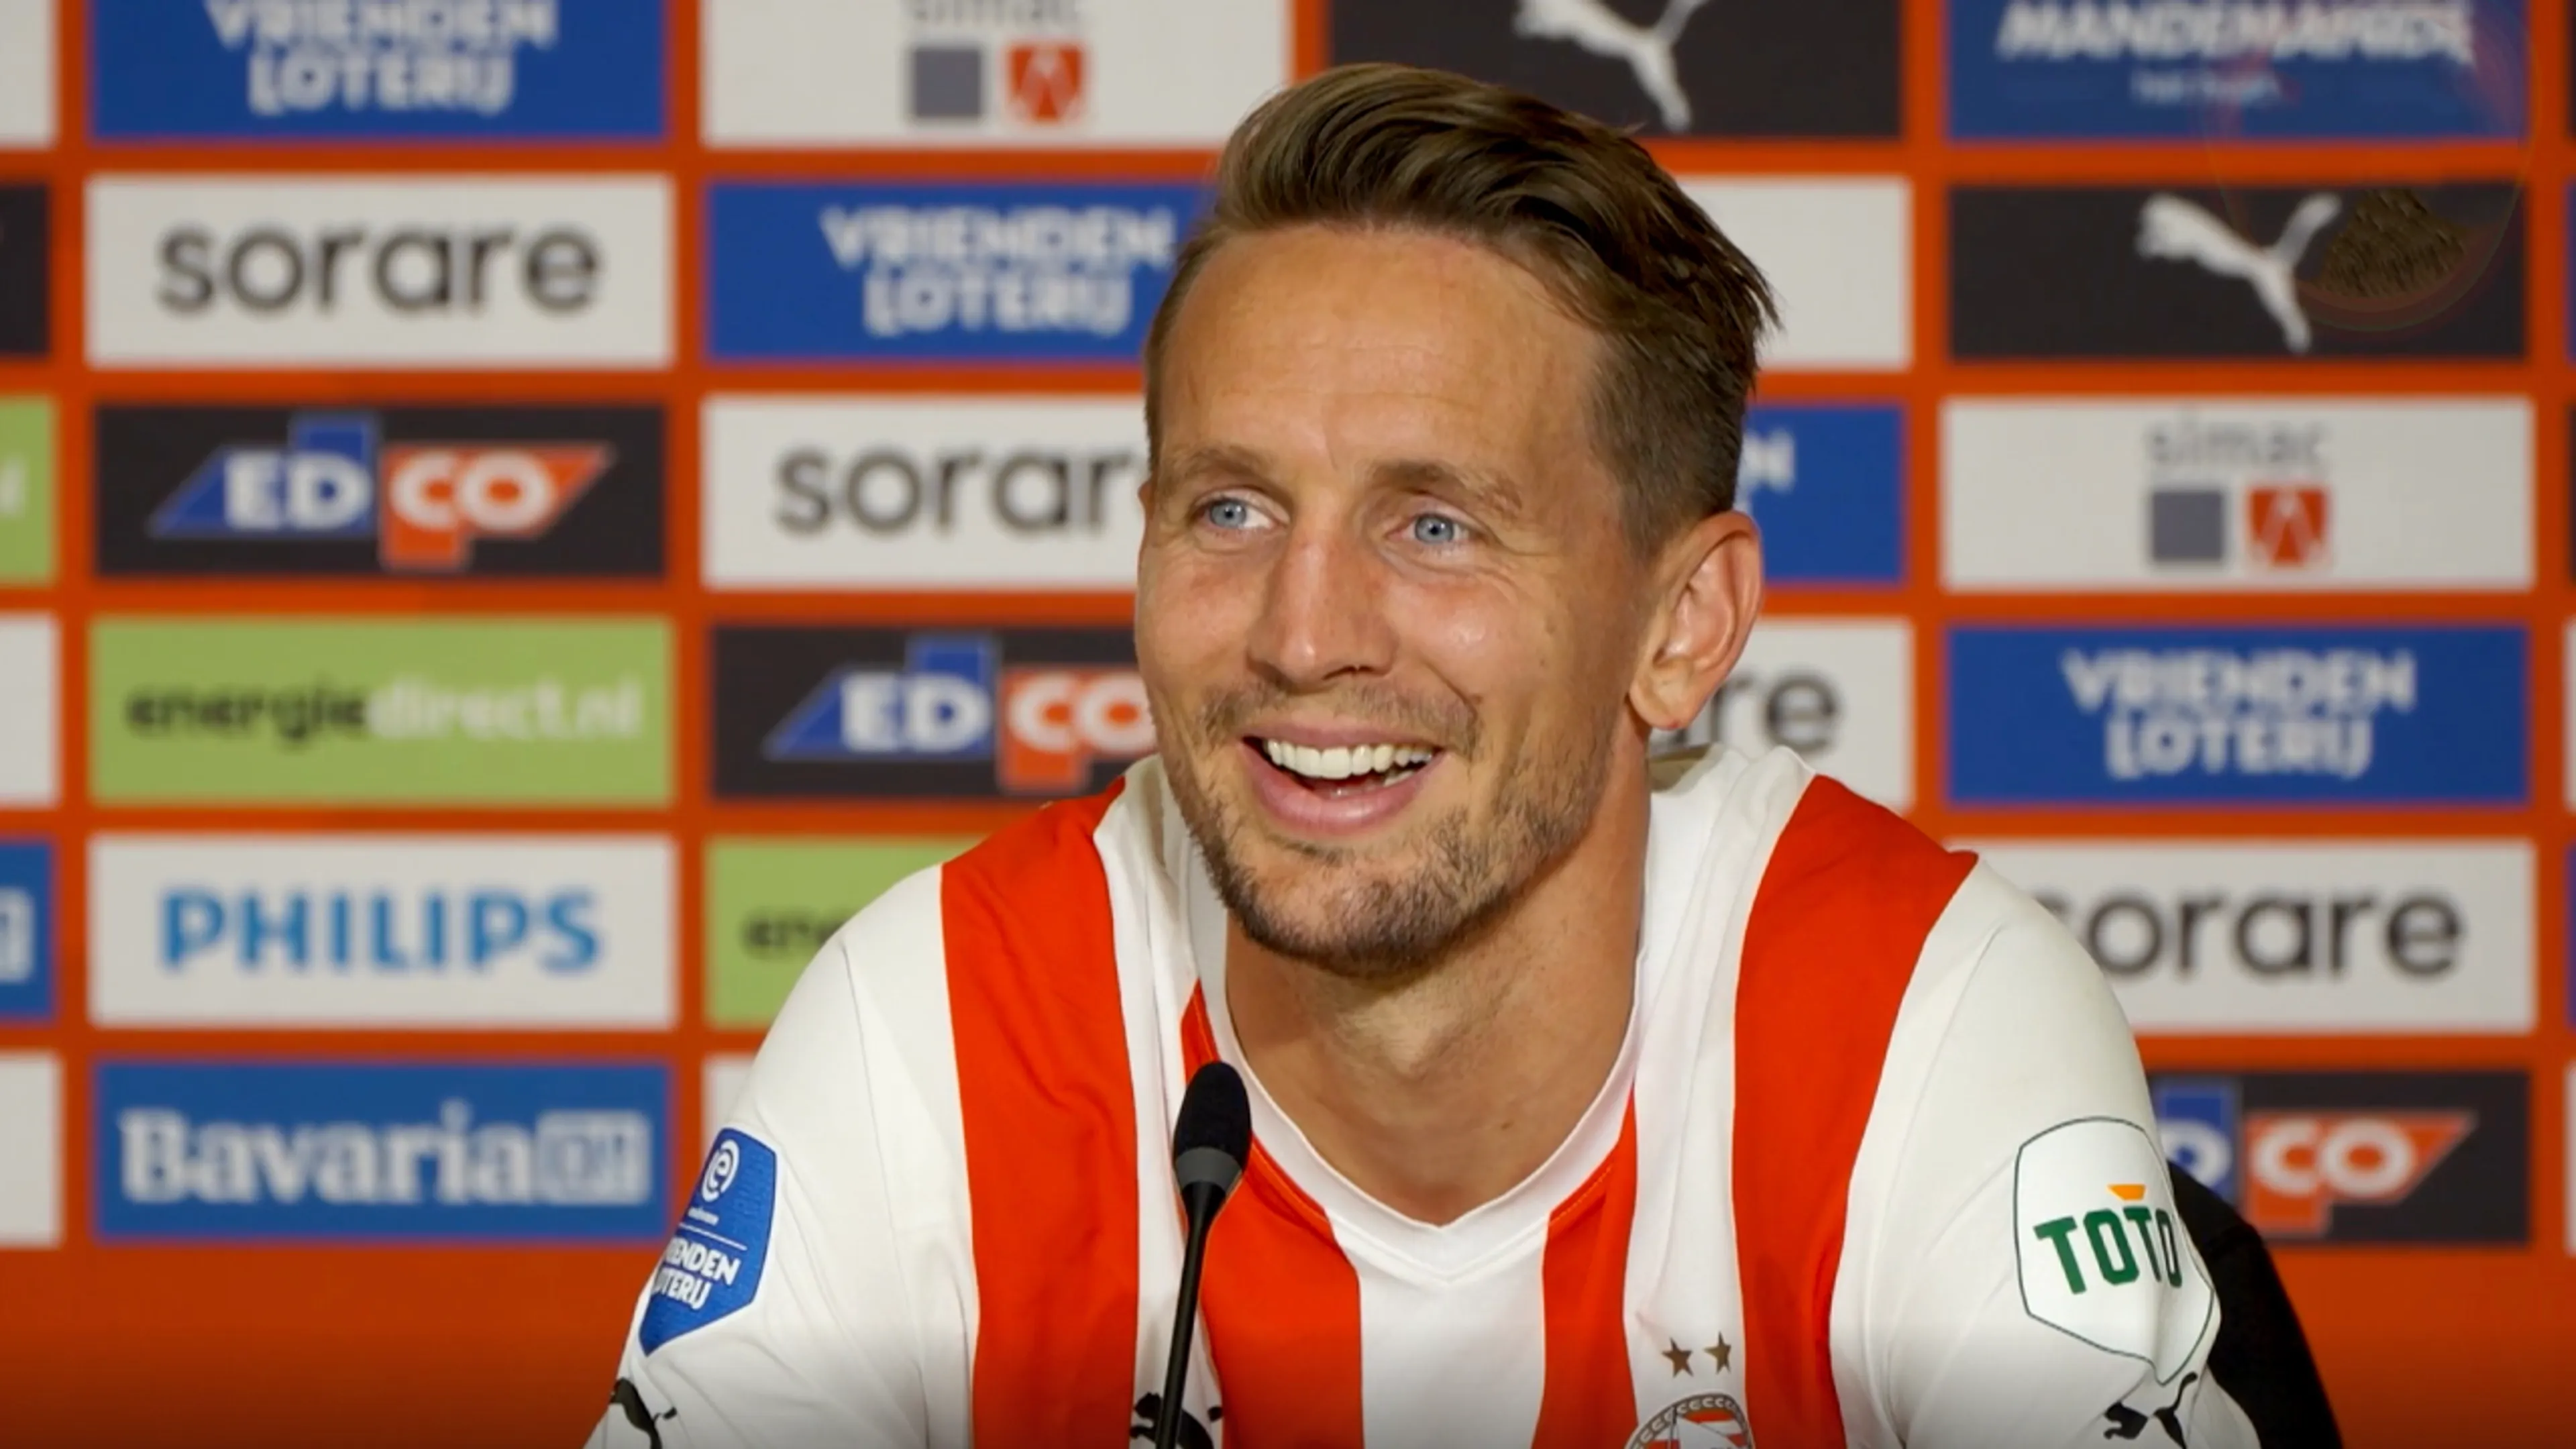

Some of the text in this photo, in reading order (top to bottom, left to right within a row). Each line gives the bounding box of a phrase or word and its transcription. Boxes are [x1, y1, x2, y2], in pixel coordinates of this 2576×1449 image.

[249, 48, 514, 115] LOTERIJ
[156, 227, 602, 317] sorare
[821, 207, 1175, 270] VRIENDEN
[863, 265, 1132, 336] LOTERIJ
[2147, 407, 2325, 468] simac
[775, 447, 1148, 539] sorar
[2063, 649, 2416, 712] VRIENDEN
[2106, 710, 2373, 779] LOTERIJ
[160, 887, 601, 973] PHILIPS
[121, 1101, 535, 1204] Bavaria
[2163, 1116, 2415, 1198] DCO
[2033, 1205, 2183, 1295] TOTO
